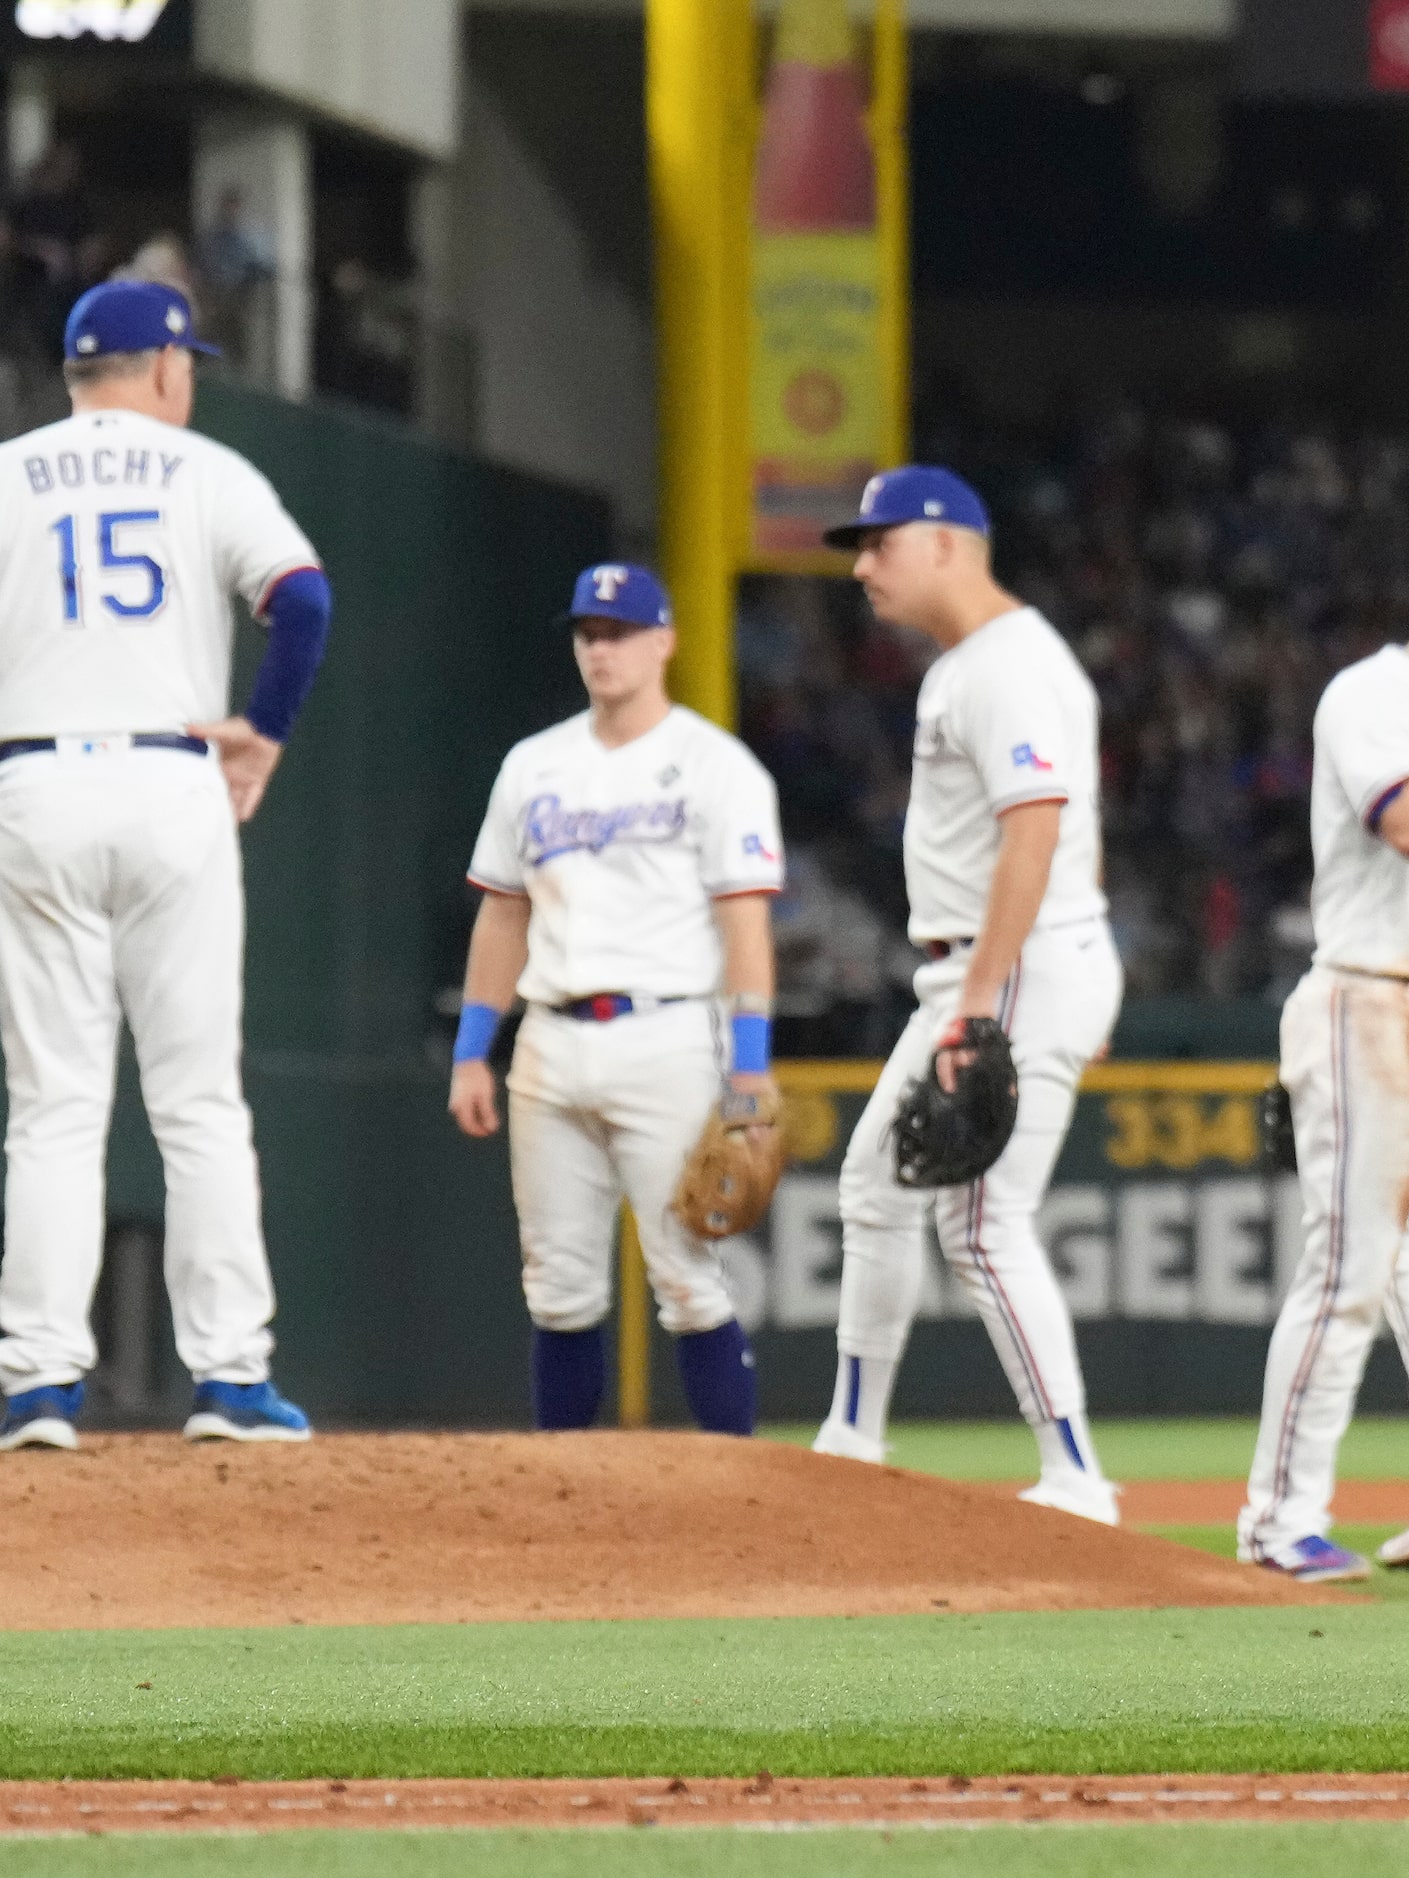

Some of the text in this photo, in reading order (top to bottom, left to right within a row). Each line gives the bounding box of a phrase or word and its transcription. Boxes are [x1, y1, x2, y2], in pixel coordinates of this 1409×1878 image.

[24, 447, 183, 495] BOCHY
[50, 508, 170, 630] 15
[592, 565, 628, 601] T
[1106, 1094, 1257, 1170] 334
